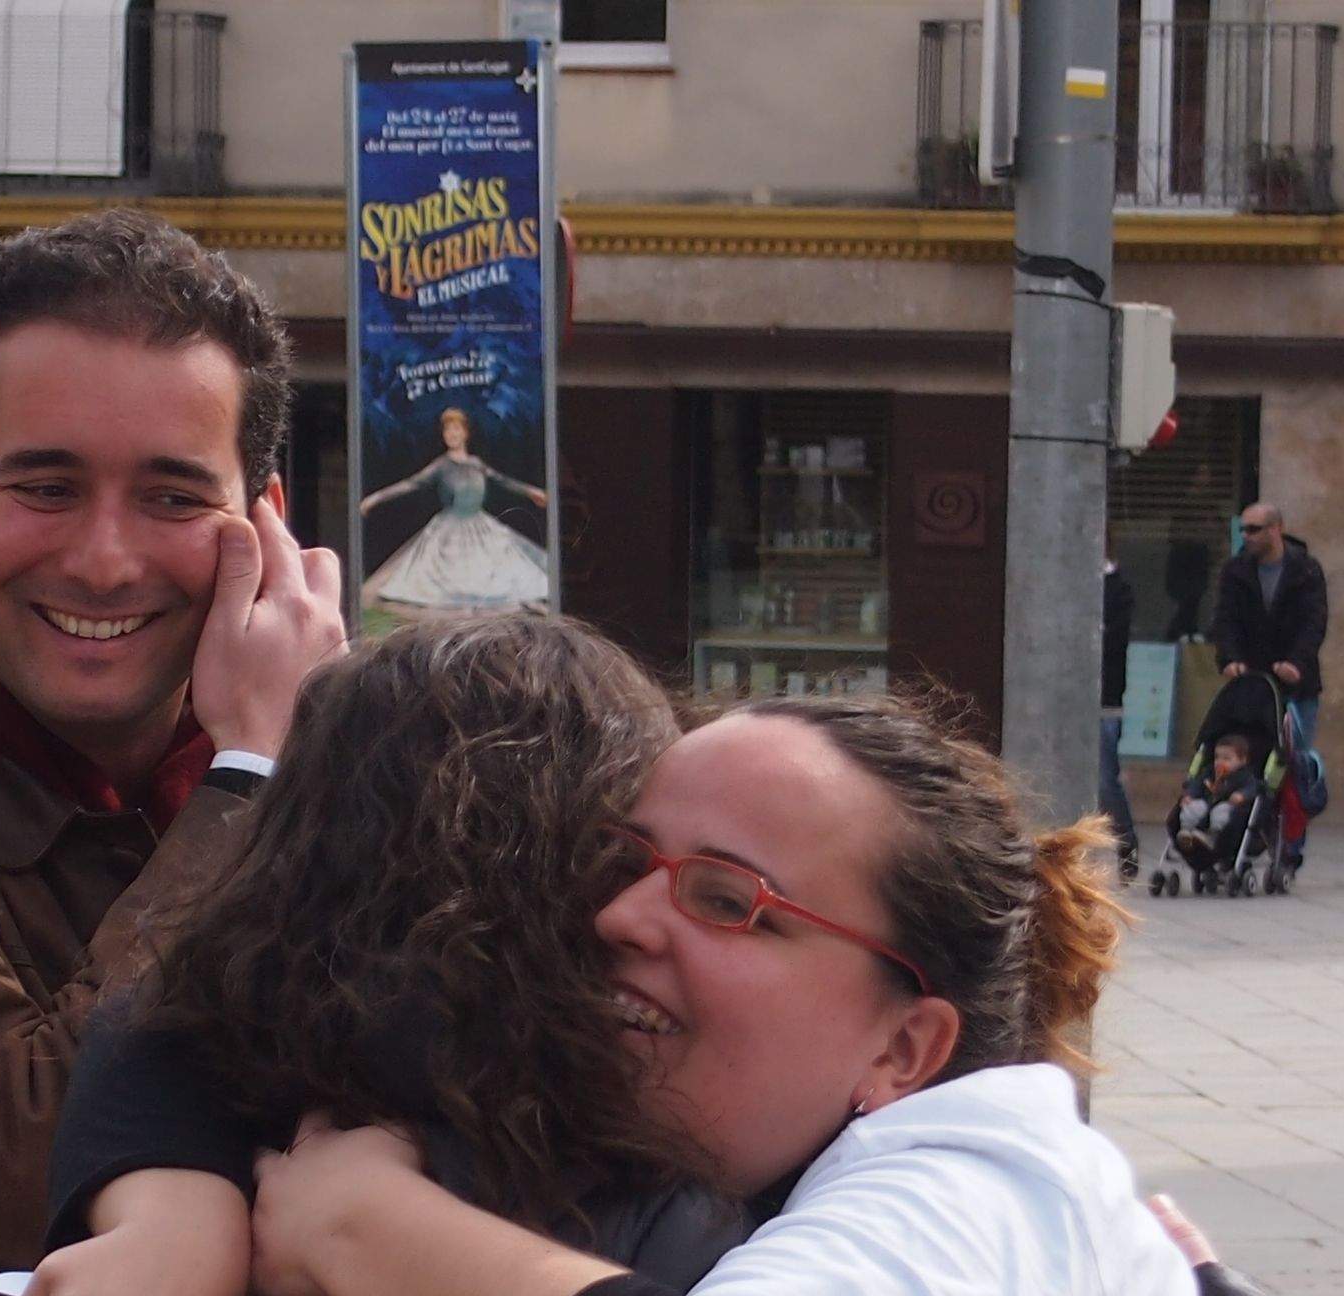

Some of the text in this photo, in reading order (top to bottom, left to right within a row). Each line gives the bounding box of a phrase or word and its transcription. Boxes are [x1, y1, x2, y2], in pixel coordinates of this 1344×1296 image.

[386, 109, 408, 124] Del
[410, 107, 432, 125] 24
[433, 110, 447, 123] al
[468, 110, 484, 123] de
[382, 123, 396, 138] El
[397, 124, 444, 137] musical
[364, 138, 386, 153] del
[361, 177, 507, 263] SONRISAS
[417, 264, 510, 307] EL MUSICAL
